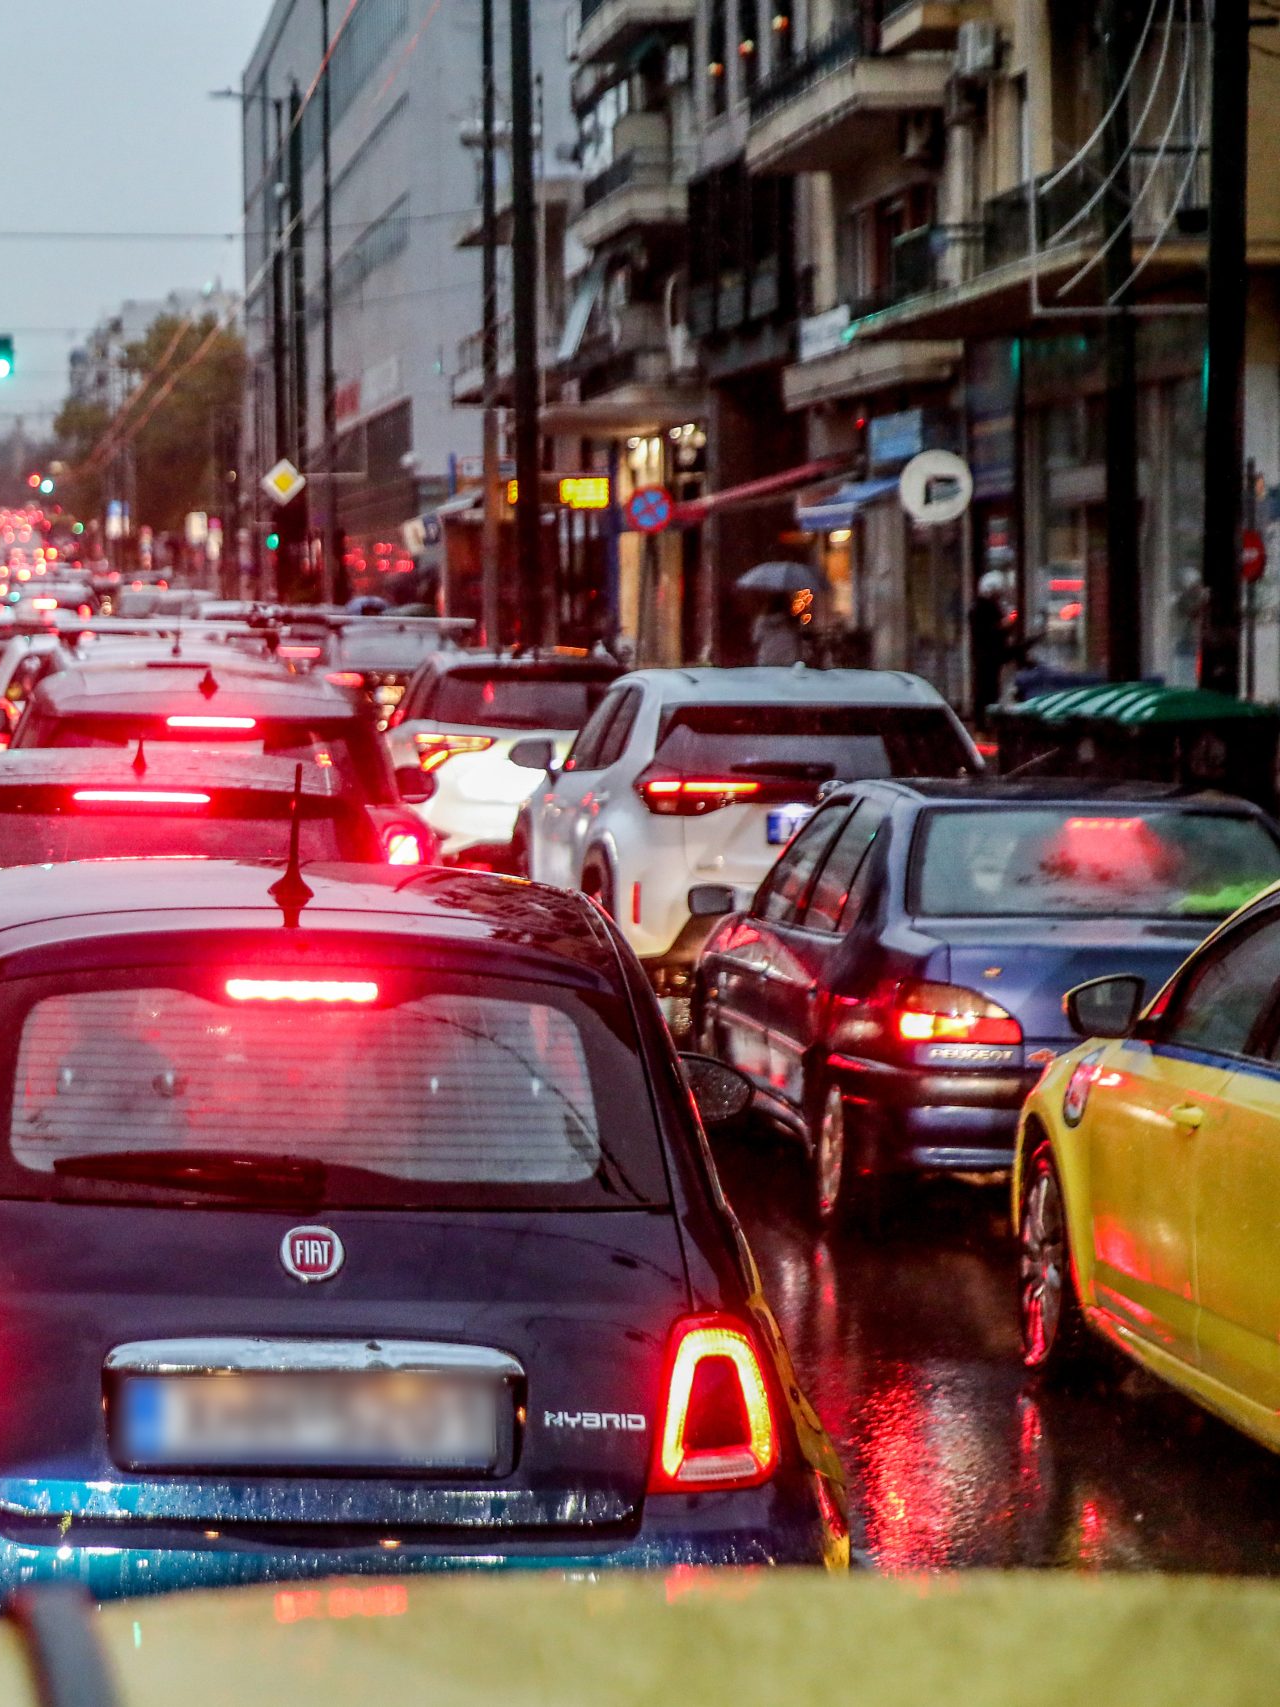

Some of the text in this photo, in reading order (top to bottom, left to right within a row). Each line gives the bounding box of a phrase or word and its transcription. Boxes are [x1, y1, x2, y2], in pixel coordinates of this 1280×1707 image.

[928, 1048, 1014, 1061] PEUGEOT
[295, 1240, 331, 1265] FIAT
[544, 1411, 646, 1431] HYBRID
